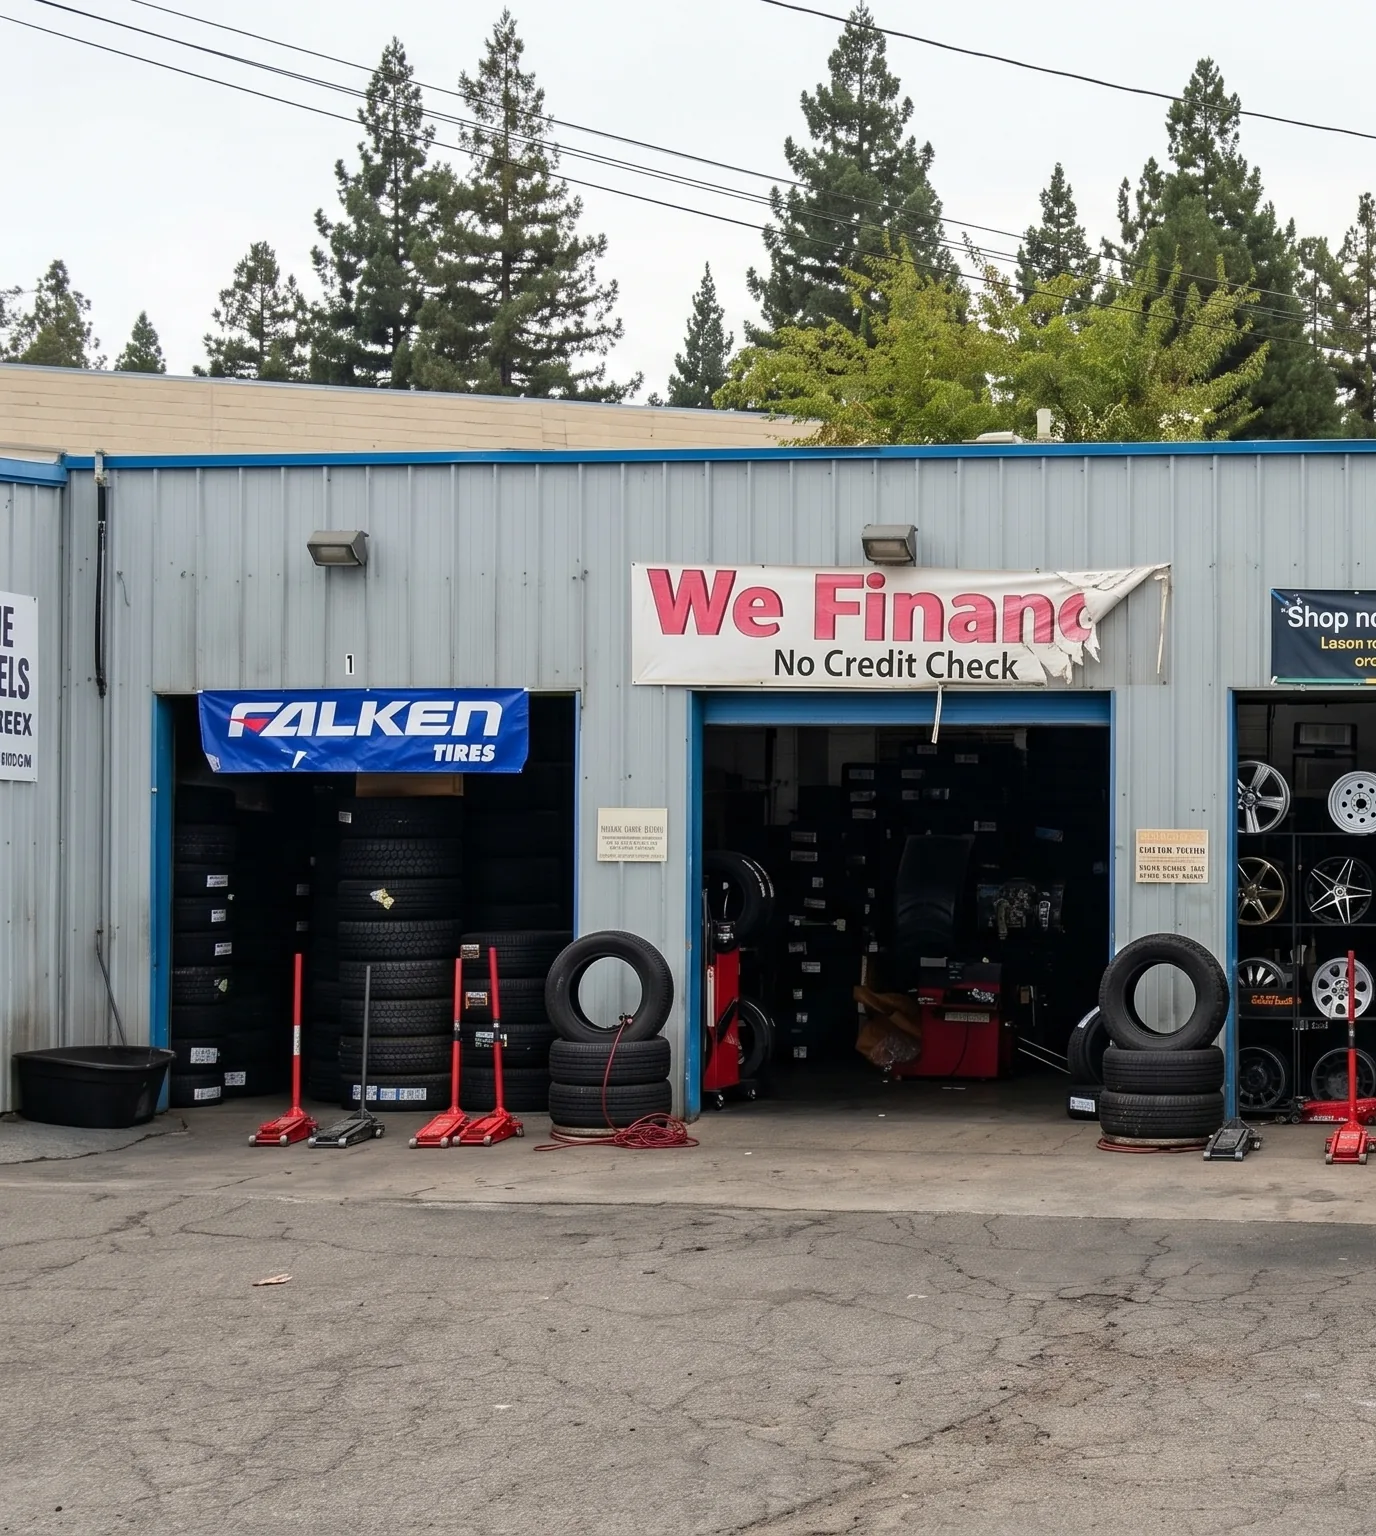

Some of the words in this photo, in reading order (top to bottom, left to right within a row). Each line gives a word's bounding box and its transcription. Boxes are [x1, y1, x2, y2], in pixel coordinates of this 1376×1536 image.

[646, 567, 784, 638] We
[1287, 605, 1349, 633] Shop
[346, 654, 354, 675] 1
[775, 649, 816, 677] No
[824, 649, 917, 680] Credit
[925, 650, 1020, 681] Check
[227, 700, 504, 738] FALKEN
[433, 743, 496, 763] TIRES
